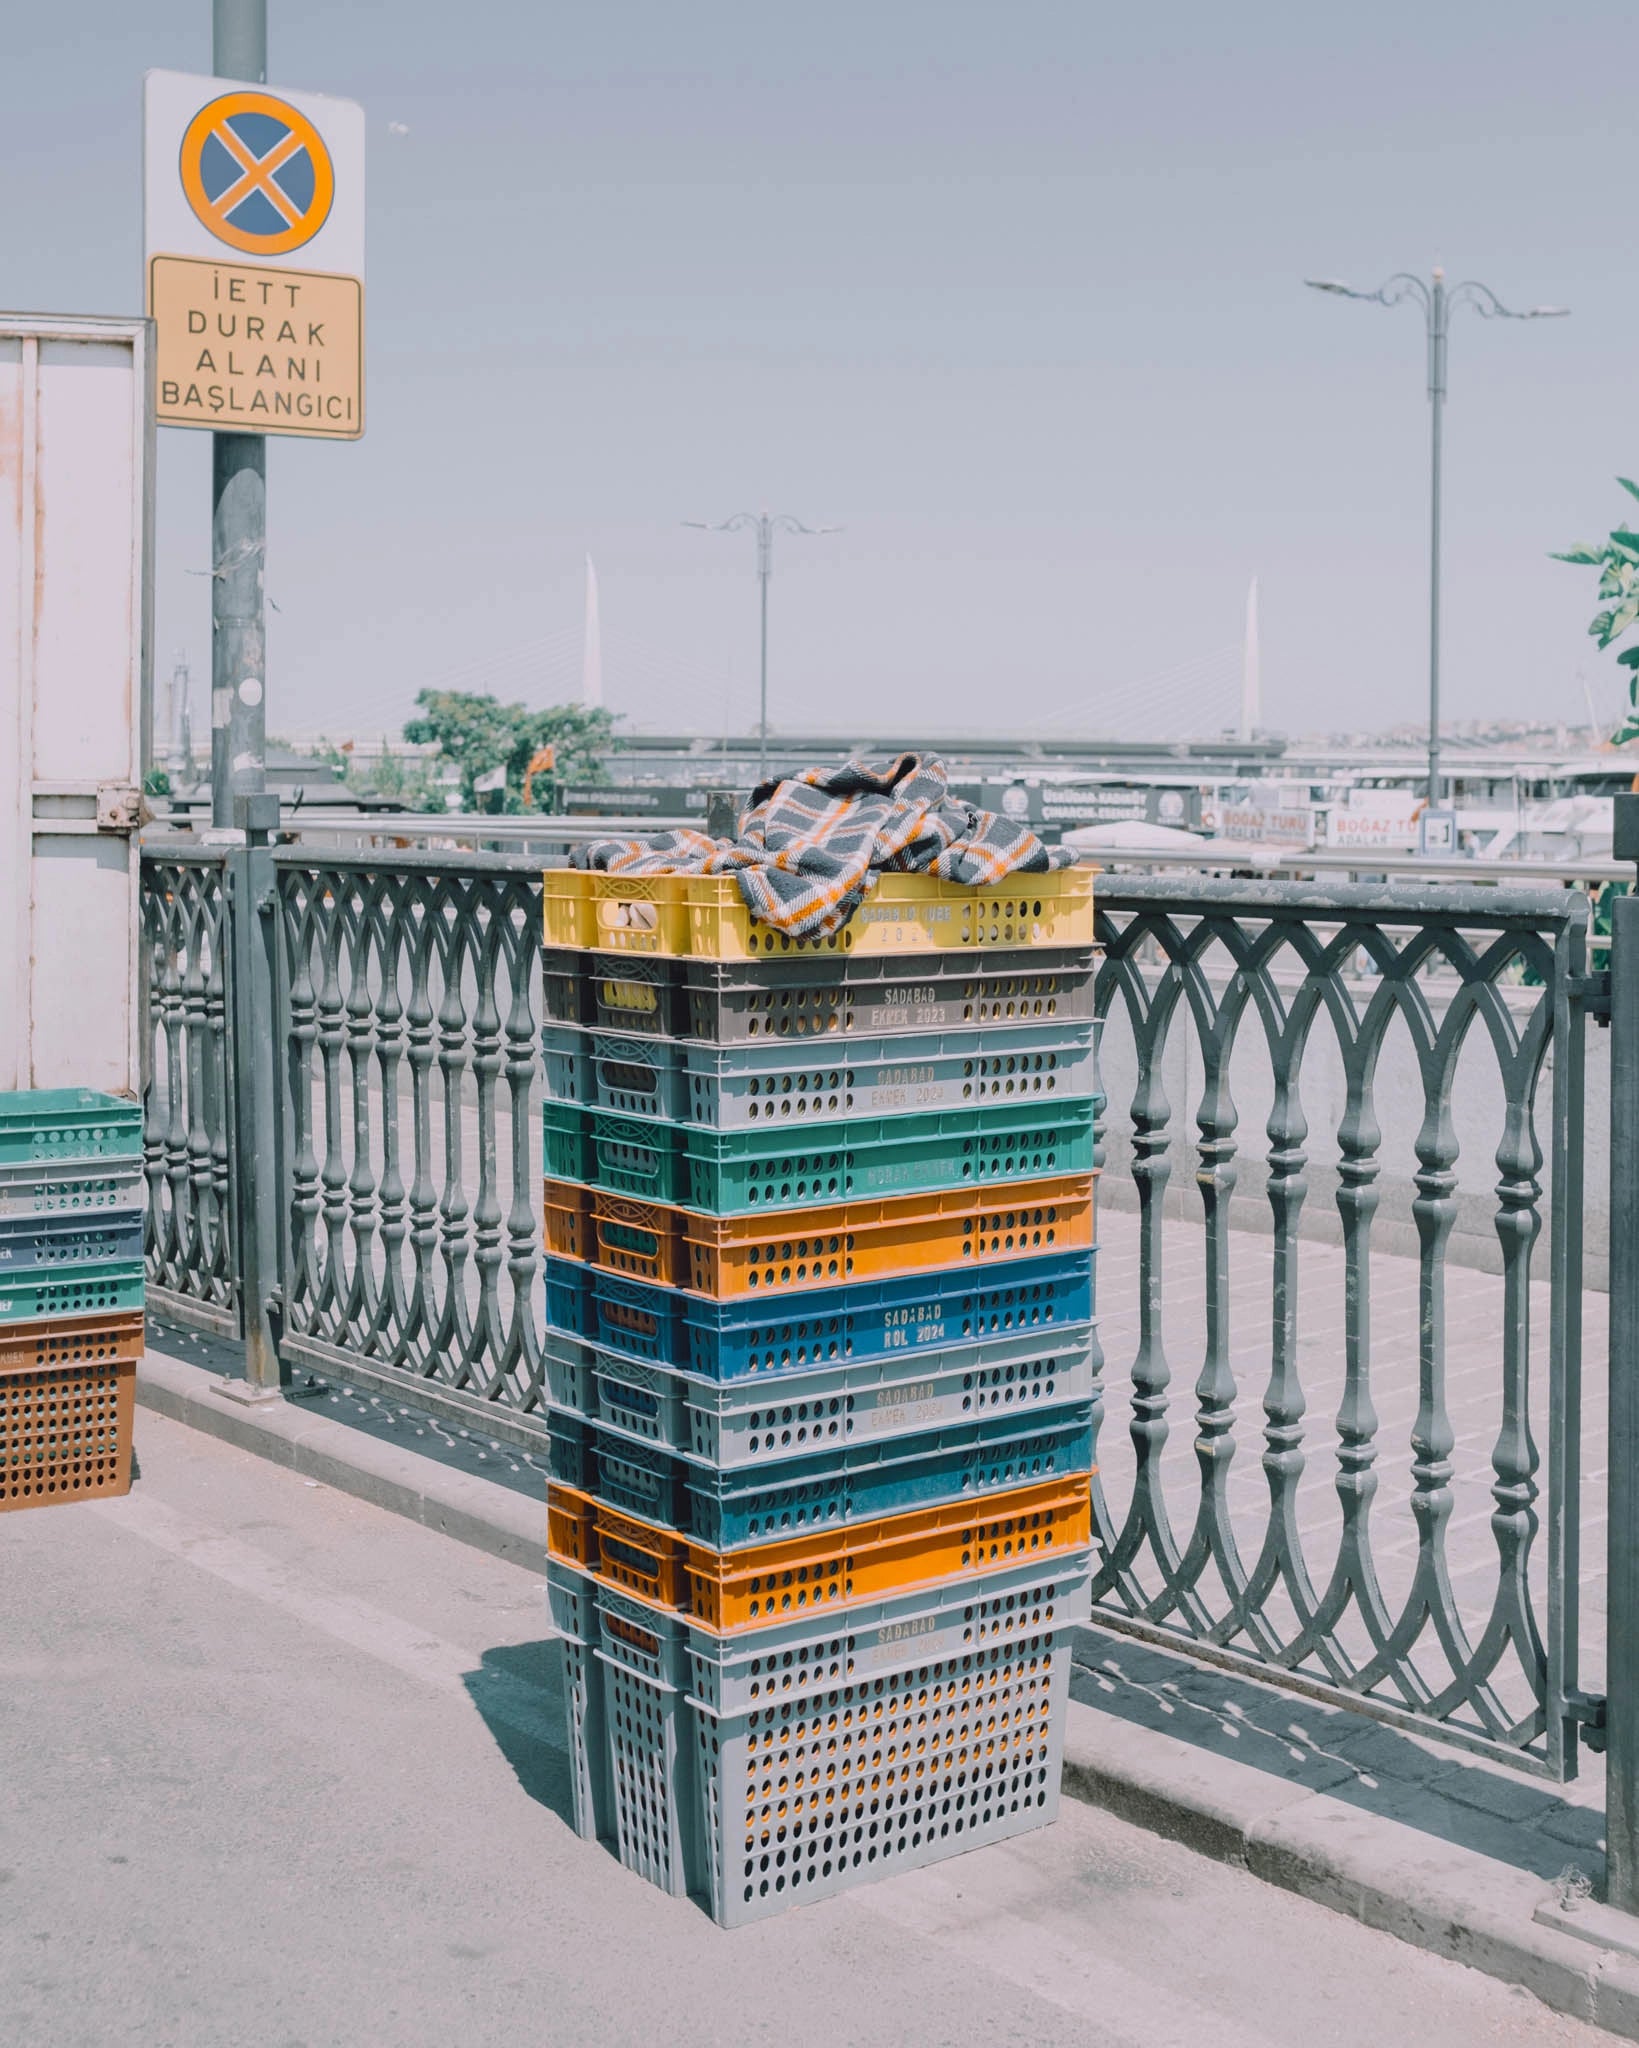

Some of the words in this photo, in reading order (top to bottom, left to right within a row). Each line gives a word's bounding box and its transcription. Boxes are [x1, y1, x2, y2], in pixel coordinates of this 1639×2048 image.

[214, 270, 301, 308] İETT
[188, 310, 325, 346] DURAK
[196, 349, 320, 382] ALANI
[162, 381, 351, 420] BAŞLANGICI
[1337, 816, 1391, 833] BOĞAZ
[884, 986, 935, 1005] SADABAD
[915, 1006, 945, 1024] 2023
[877, 1066, 934, 1086] SADABAD
[884, 1304, 941, 1327] SADABAD
[884, 1329, 908, 1348] ROL
[916, 1323, 945, 1342] 2024
[879, 1616, 935, 1643] SADABAD
